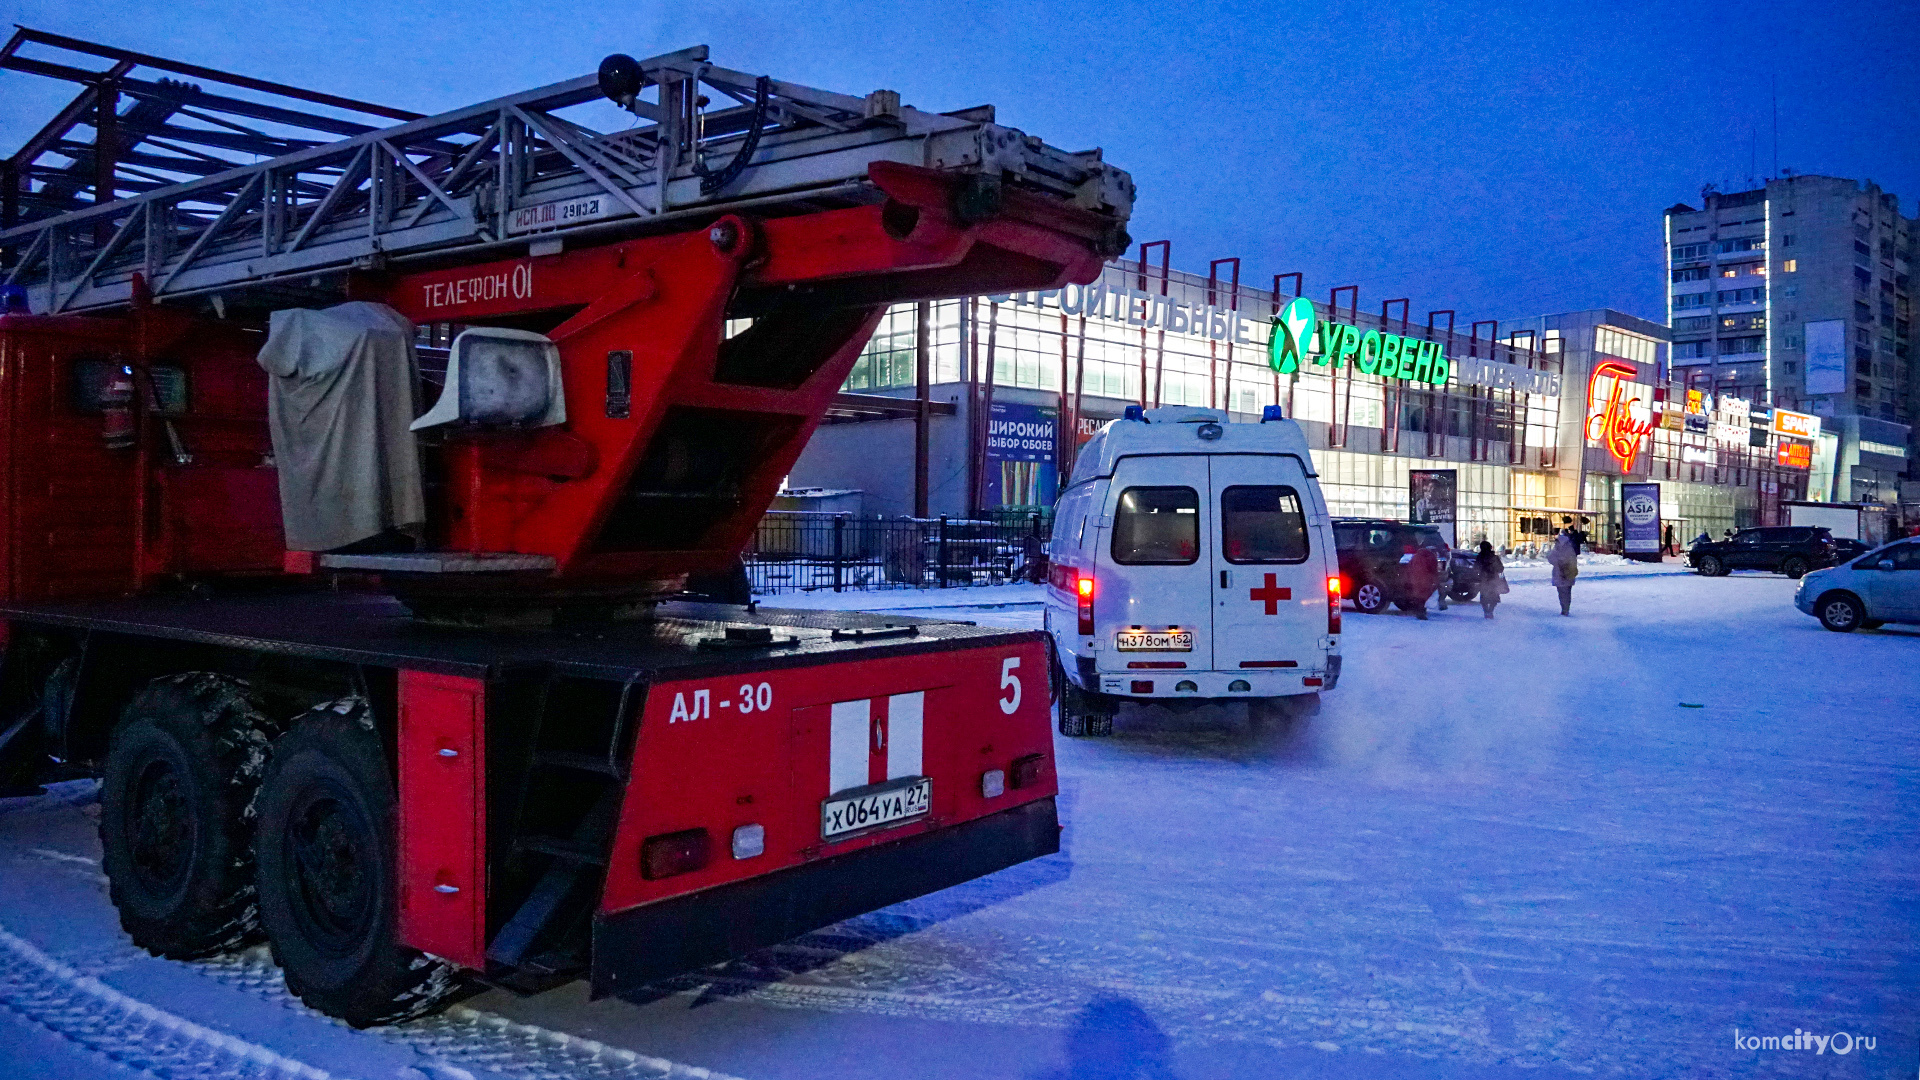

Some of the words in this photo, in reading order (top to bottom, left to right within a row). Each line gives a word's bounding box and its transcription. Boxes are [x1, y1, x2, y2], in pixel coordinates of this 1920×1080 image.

[423, 273, 507, 308] ТЕЛЕФОН
[512, 262, 532, 300] 01
[986, 283, 1251, 345] РОИТЕЛЬНЫЕ
[1314, 319, 1450, 386] УРОВЕНЬ
[1022, 439, 1053, 451] ОБОЕВ
[1782, 414, 1809, 433] SPAR
[1627, 504, 1654, 514] ASIA
[1122, 635, 1169, 647] Н378ОМ
[1171, 634, 1189, 644] 152
[669, 689, 710, 724] АЛ
[739, 682, 773, 714] 30
[1000, 656, 1021, 715] 5
[832, 796, 903, 831] Х064УА
[907, 784, 923, 806] 27
